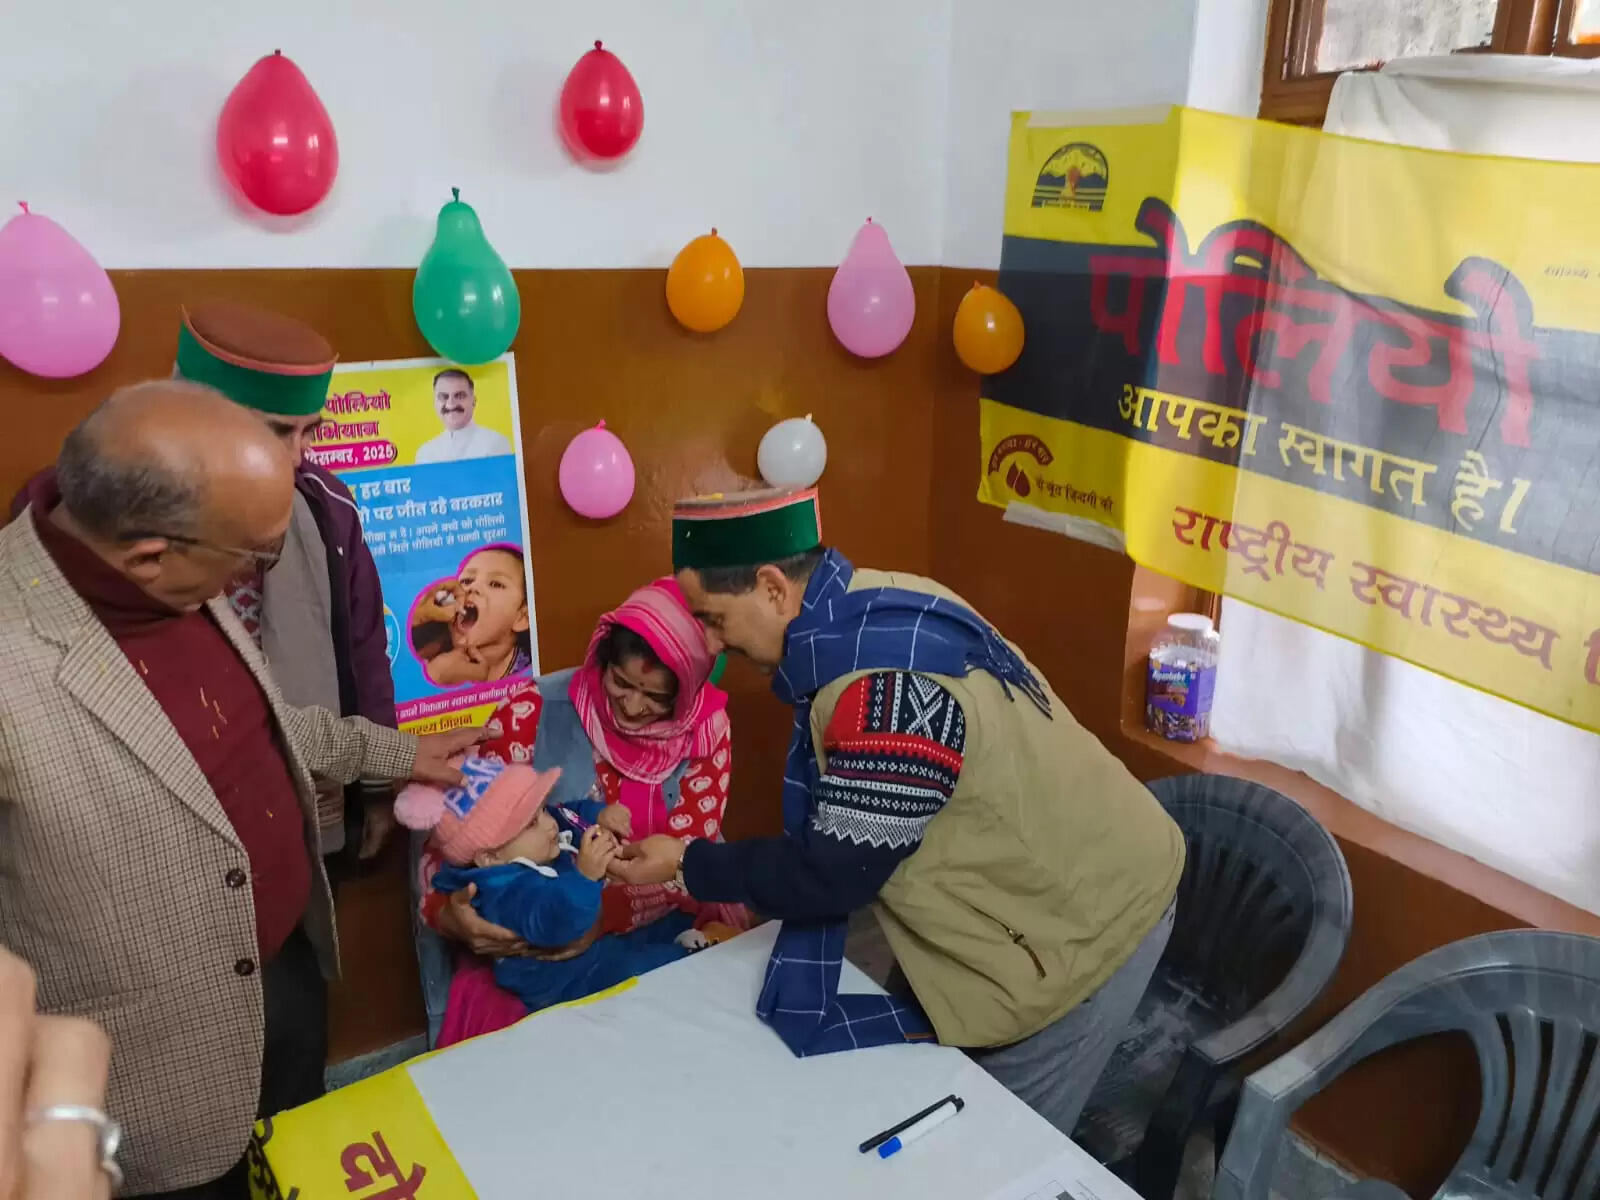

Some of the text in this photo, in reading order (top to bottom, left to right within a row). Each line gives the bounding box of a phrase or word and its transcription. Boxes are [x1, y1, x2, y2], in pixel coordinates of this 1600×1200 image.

[1088, 203, 1540, 448] पोलियो
[311, 419, 379, 441] भियान
[1118, 383, 1267, 456] आपका
[1278, 421, 1438, 507] स्वागत
[1172, 505, 1335, 591] राष्ट्रीय
[1349, 560, 1561, 671] स्वास्थ्य
